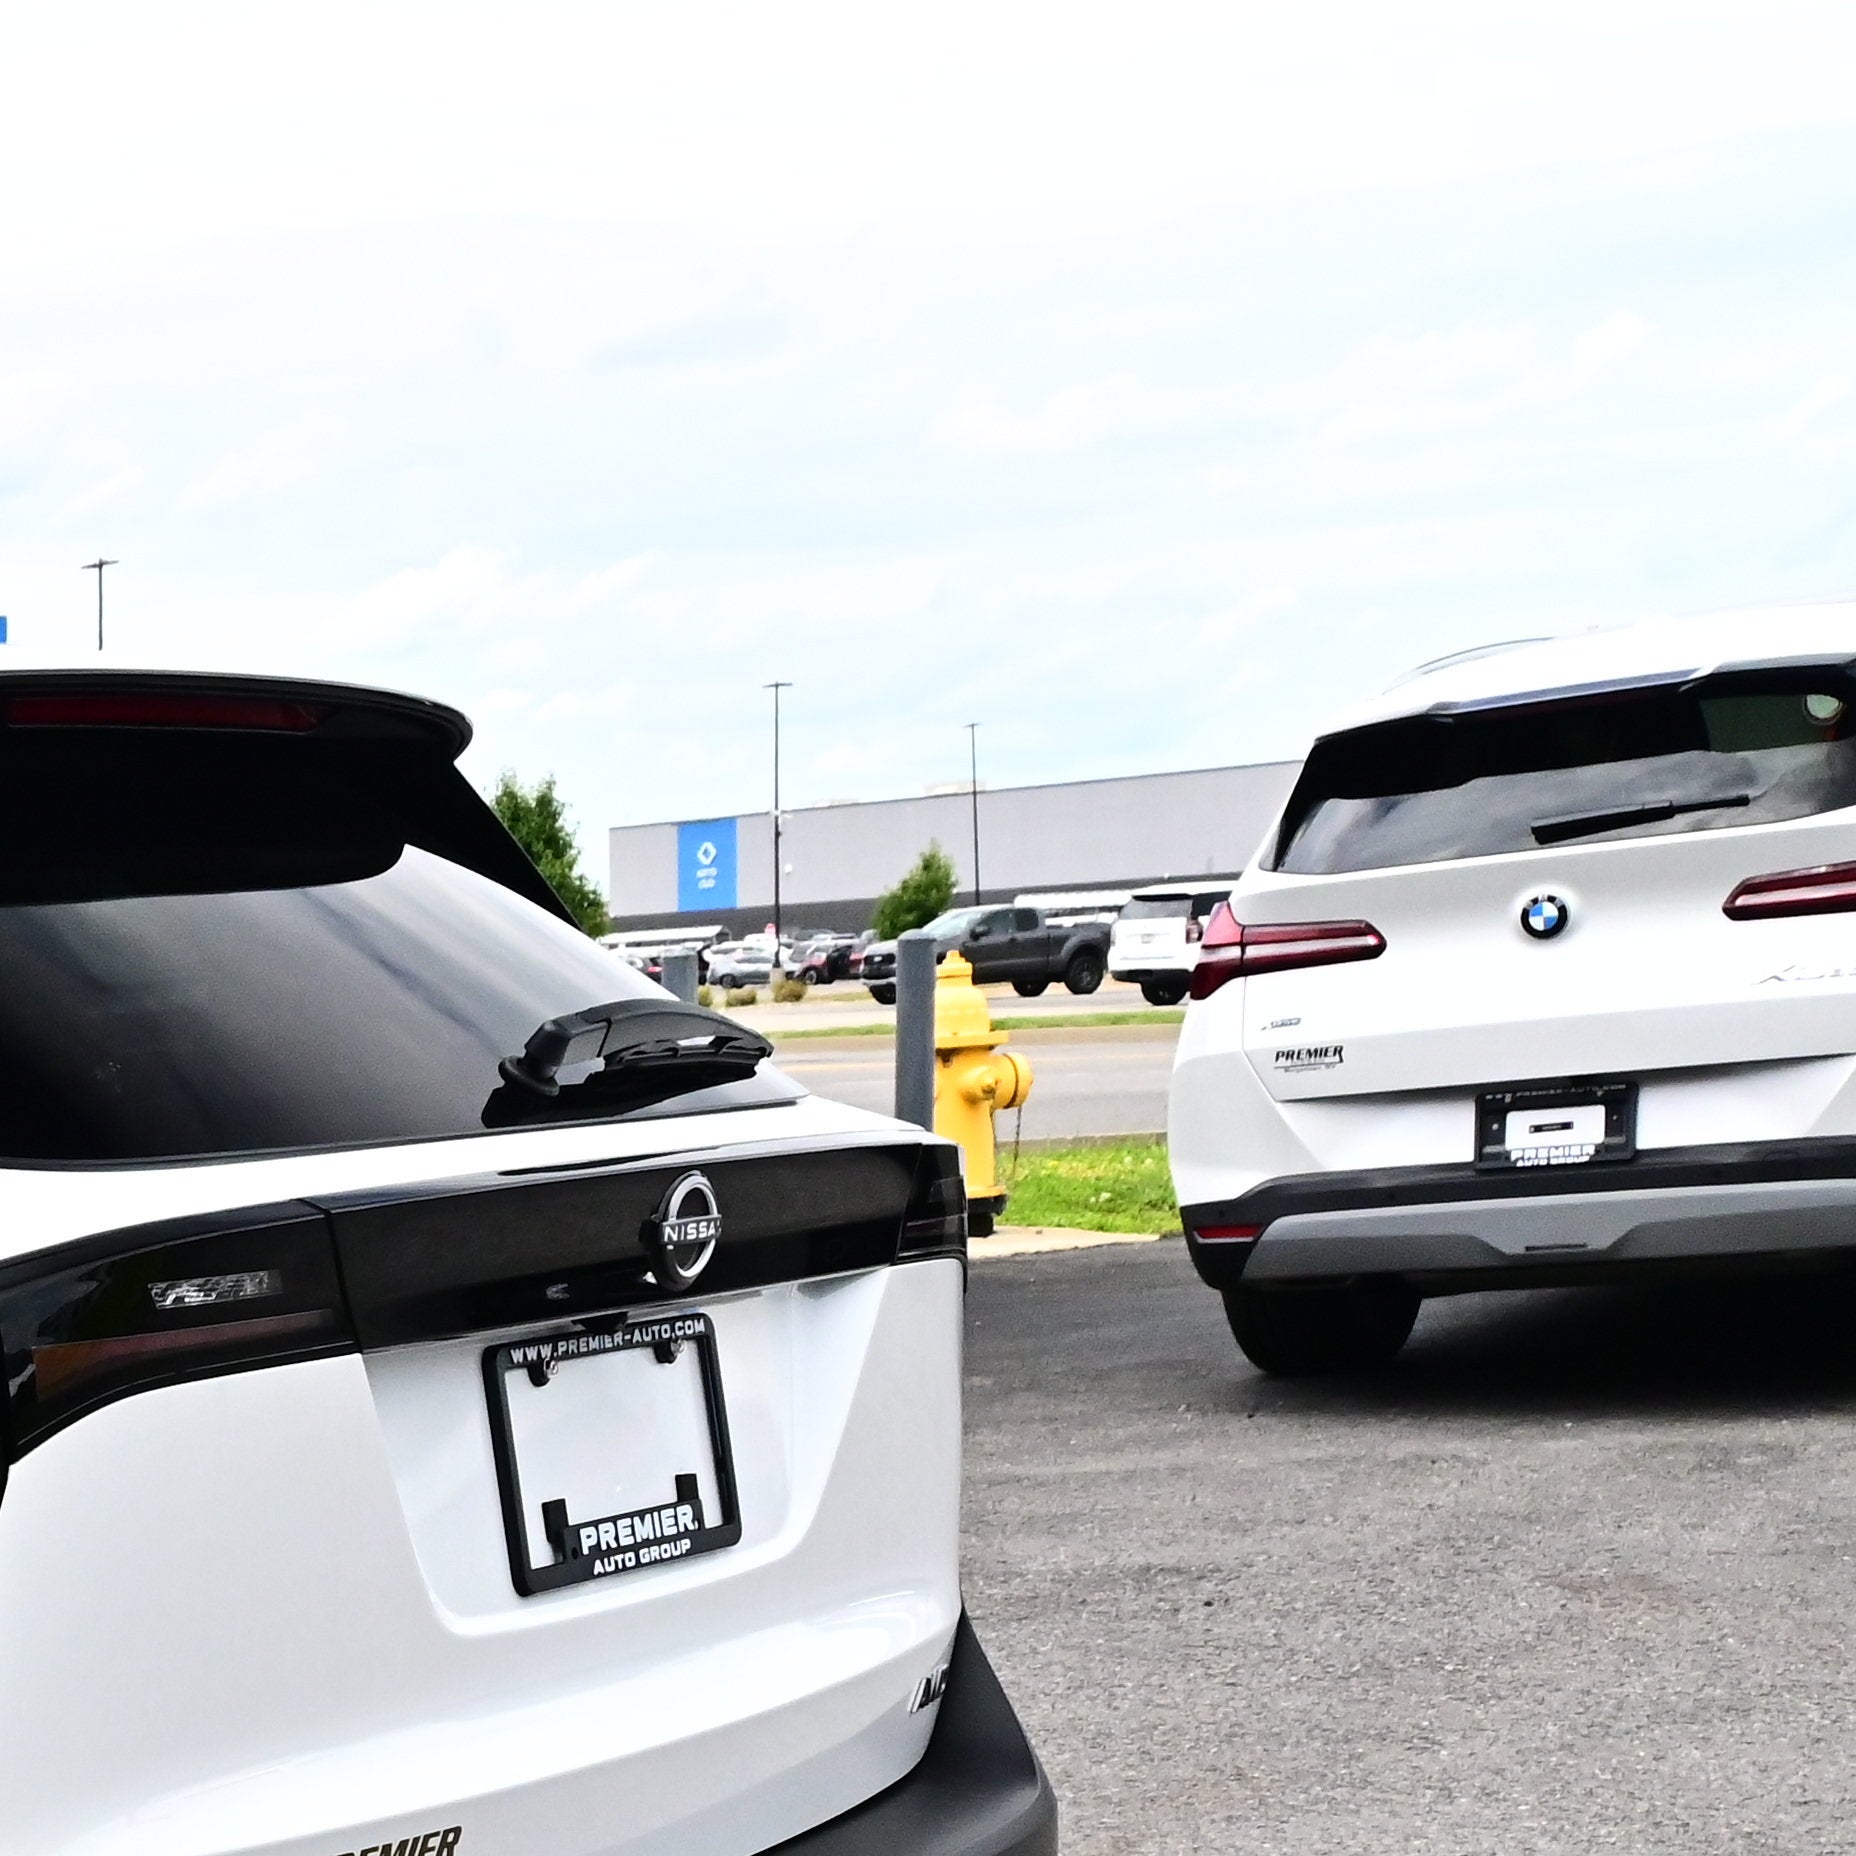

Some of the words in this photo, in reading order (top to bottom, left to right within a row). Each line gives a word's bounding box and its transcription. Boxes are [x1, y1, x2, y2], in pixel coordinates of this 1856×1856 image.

[1274, 1044, 1344, 1064] PREMIER
[1510, 1144, 1596, 1162] PREMIER
[510, 1318, 706, 1364] WWW.PREMIER-AUTO.COM
[579, 1504, 696, 1555] PREMIER
[593, 1551, 636, 1575] AUTO
[638, 1538, 691, 1564] GROUP
